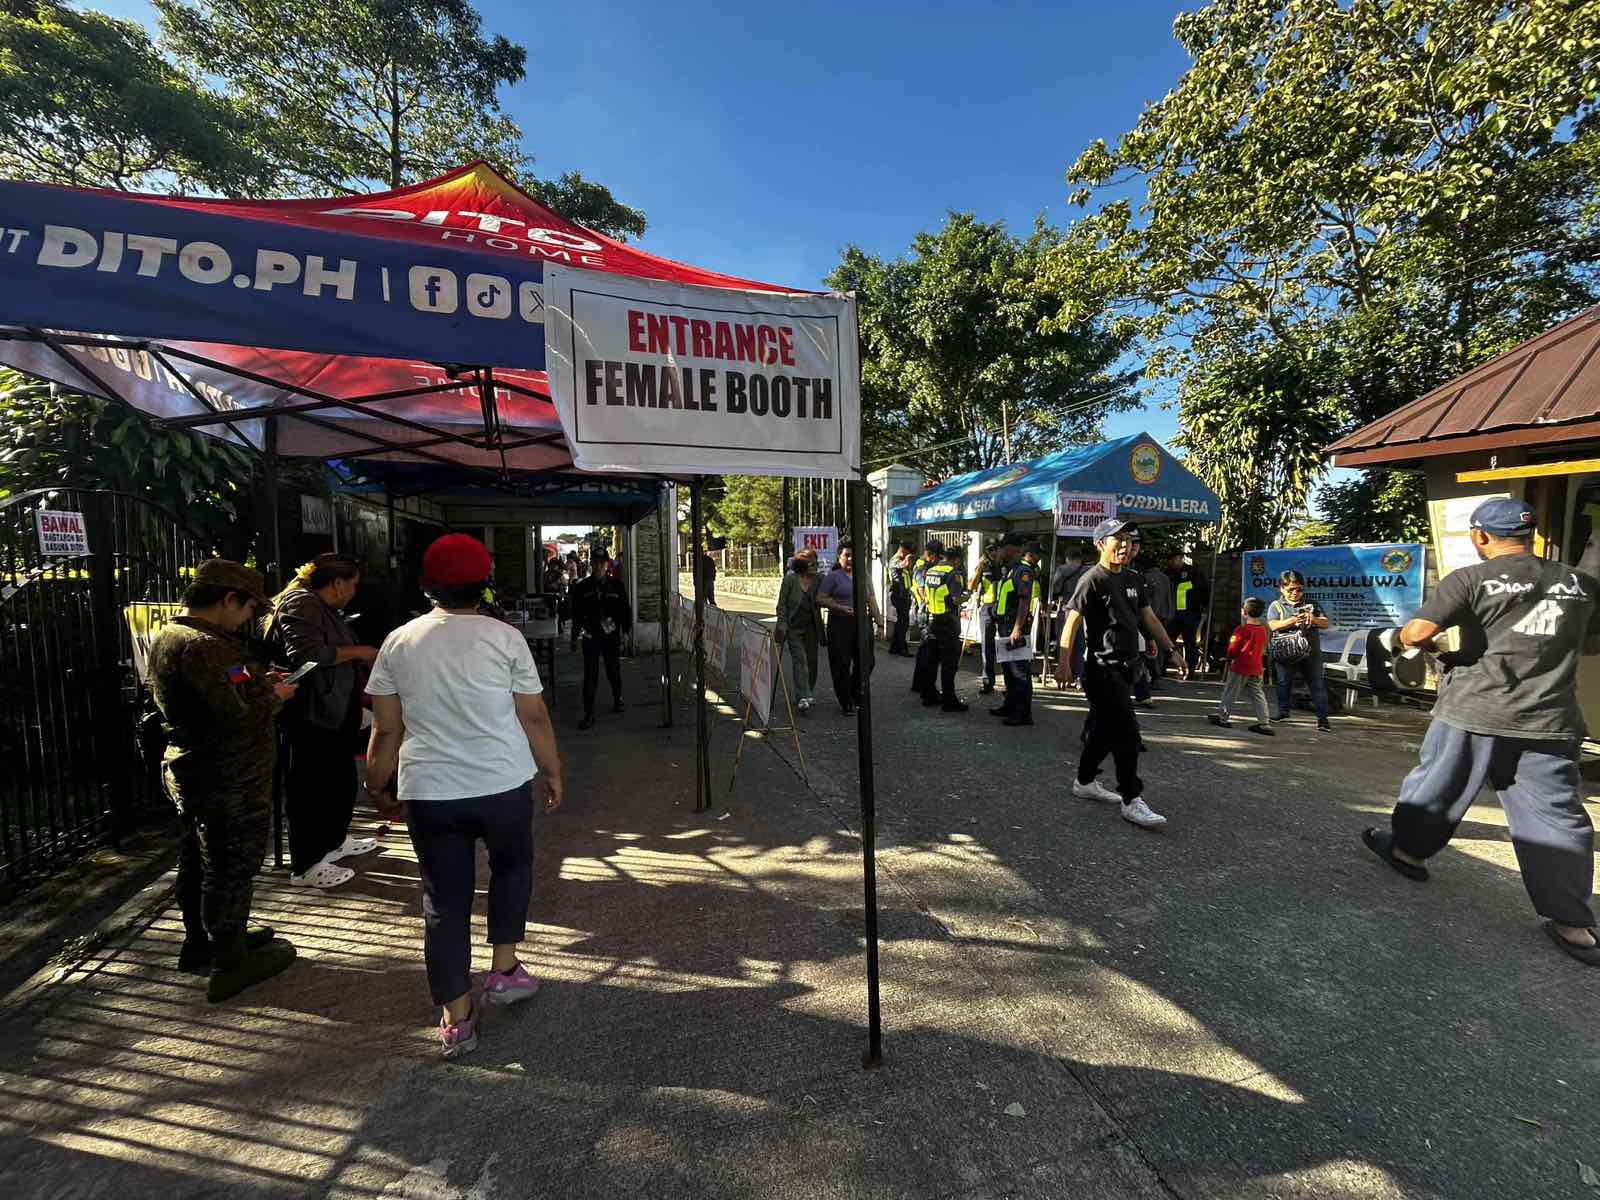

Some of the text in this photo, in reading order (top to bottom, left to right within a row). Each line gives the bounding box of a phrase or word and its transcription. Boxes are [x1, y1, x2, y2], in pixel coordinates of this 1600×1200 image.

[441, 230, 607, 267] HOME
[37, 224, 357, 300] DITO.PH
[627, 309, 796, 367] ENTRANCE
[585, 359, 832, 419] FEMALE BOOTH
[1067, 500, 1105, 513] ENTRANCE
[41, 516, 83, 533] BAWAL
[1062, 514, 1082, 527] MALE
[1083, 514, 1109, 528] BOOT
[804, 534, 829, 549] EXIT
[1306, 574, 1408, 588] KALULUWA
